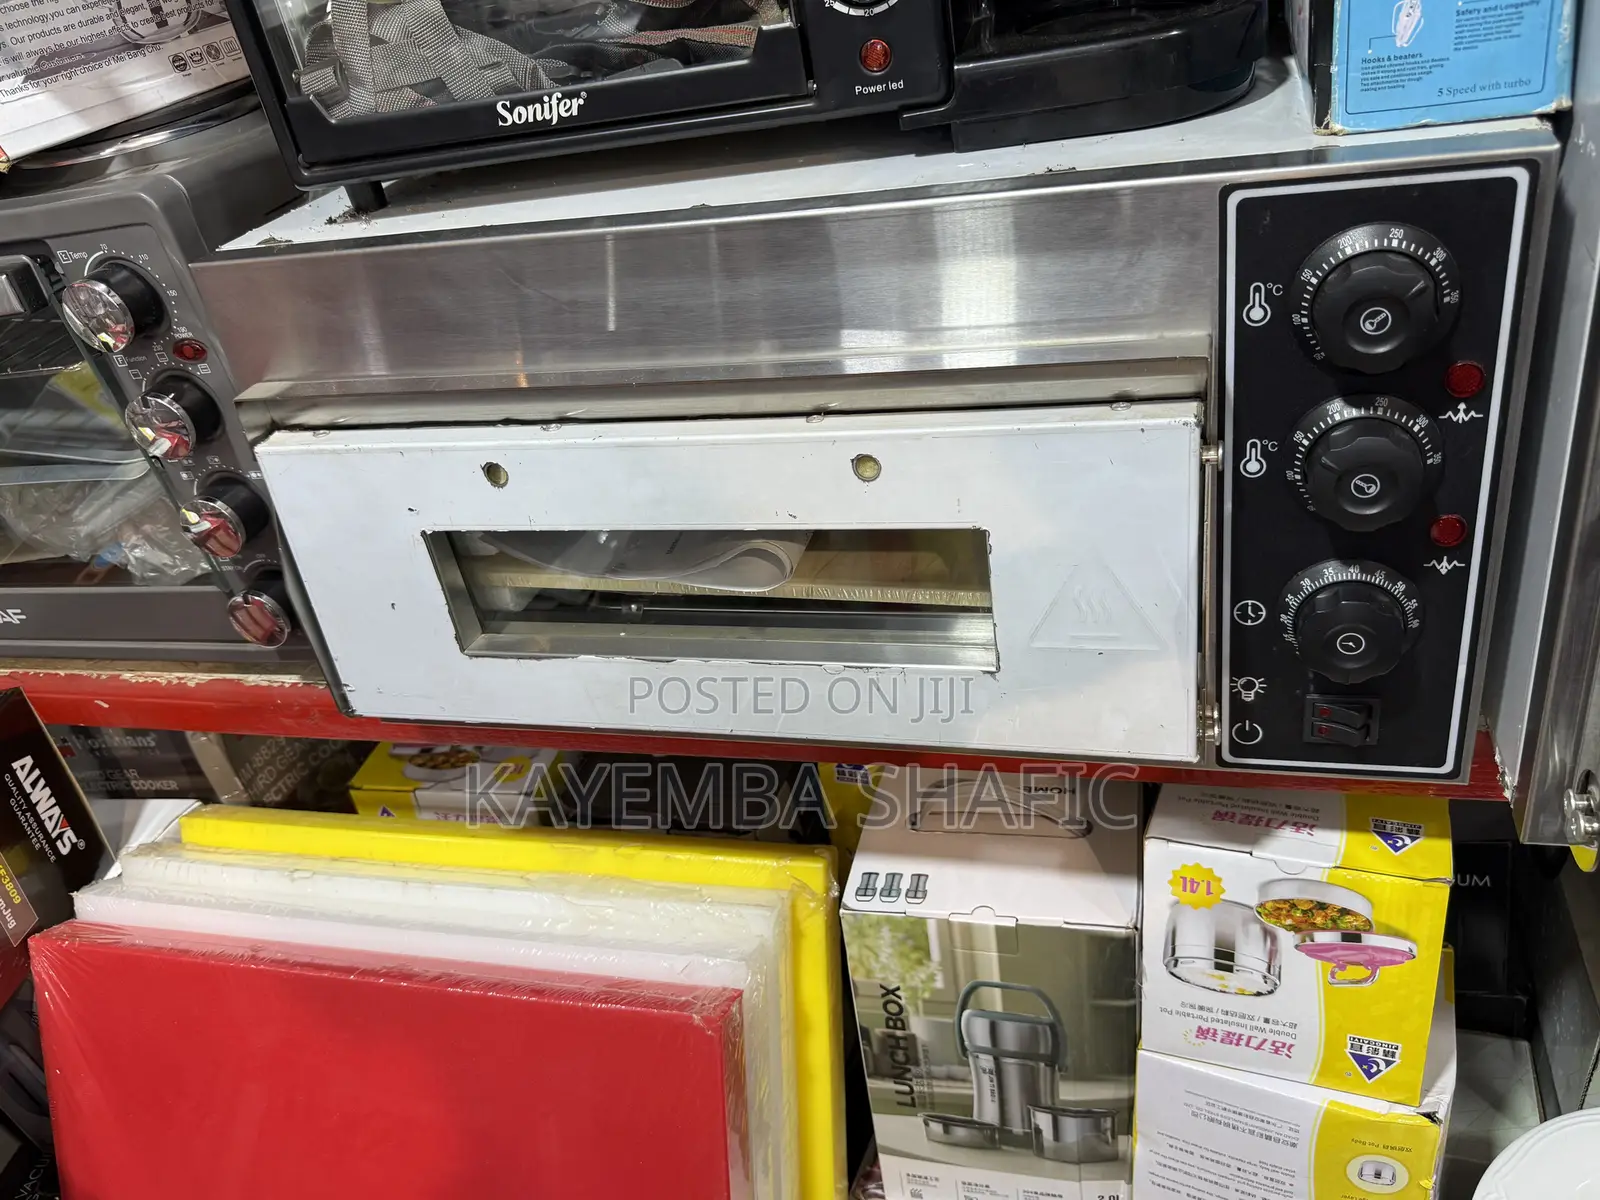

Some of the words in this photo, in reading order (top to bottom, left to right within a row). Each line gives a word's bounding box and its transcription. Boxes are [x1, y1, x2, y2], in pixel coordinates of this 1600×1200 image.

[0, 2, 30, 14] choose
[66, 6, 80, 15] can
[864, 8, 875, 17] 20
[1456, 8, 1482, 17] Safety
[1482, 5, 1498, 13] and
[10, 36, 26, 46] Our
[27, 26, 62, 42] products
[63, 24, 76, 32] are
[78, 14, 104, 28] durable
[106, 10, 120, 20] and
[121, 4, 148, 18] elegant,
[12, 52, 24, 62] will
[26, 46, 53, 58] always
[54, 43, 64, 52] be
[66, 39, 80, 48] our
[80, 30, 108, 44] highest
[109, 23, 131, 36] effects
[132, 20, 139, 28] to
[140, 14, 160, 26] create
[176, 3, 204, 18] products
[1361, 56, 1386, 64] Hooks
[1393, 52, 1423, 61] beaters
[0, 83, 30, 98] Thanks
[30, 80, 41, 89] for
[44, 74, 60, 88] your
[60, 69, 79, 80] right
[80, 62, 104, 74] choice
[104, 58, 112, 66] of
[112, 53, 126, 64] Mei
[127, 48, 146, 60] Bang
[146, 43, 164, 54] Chu.
[7, 64, 40, 80] valuable
[855, 84, 886, 95] Power
[888, 79, 904, 90] led
[1438, 88, 1444, 97] 5
[1446, 81, 1477, 97] Speed
[1479, 78, 1502, 92] with
[1504, 77, 1531, 90] turbo
[496, 91, 585, 127] Sonifer
[70, 252, 88, 260] Temp
[1292, 314, 1300, 326] 100
[1300, 268, 1314, 283] 150
[1338, 236, 1352, 250] 200
[1389, 228, 1404, 240] 250
[1432, 246, 1446, 262] 300
[1293, 431, 1304, 443] 150
[1326, 402, 1341, 415] 200
[1374, 397, 1389, 408] 250
[1416, 414, 1429, 428] 300
[1285, 594, 1295, 605] 25
[1300, 578, 1311, 589] 30
[1323, 566, 1334, 578] 35
[1348, 564, 1360, 573] 40
[1374, 569, 1386, 579] 45
[1395, 580, 1406, 592] 50
[1408, 598, 1418, 610] 55
[106, 768, 140, 779] GEAR
[131, 779, 180, 791] COOKER
[1022, 784, 1076, 796] HOME
[11, 754, 78, 856] ALWAYS
[4, 773, 28, 811] QUALITY
[25, 811, 57, 864] ASSURANCE
[9, 798, 41, 851] GUARANTEE
[1211, 809, 1318, 837] 活力提锅
[1290, 812, 1319, 822] Double
[1179, 875, 1215, 897] 1.4L
[879, 983, 906, 1031] BOX
[1159, 1006, 1173, 1016] Pot
[1175, 1010, 1209, 1023] Portable
[1210, 1017, 1248, 1031] Insulated
[1249, 1024, 1267, 1034] Wall
[1268, 1028, 1297, 1040] Double
[1194, 1024, 1296, 1059] 活力提锅
[887, 1034, 917, 1108] LUNCH
[1351, 1138, 1366, 1146] Body
